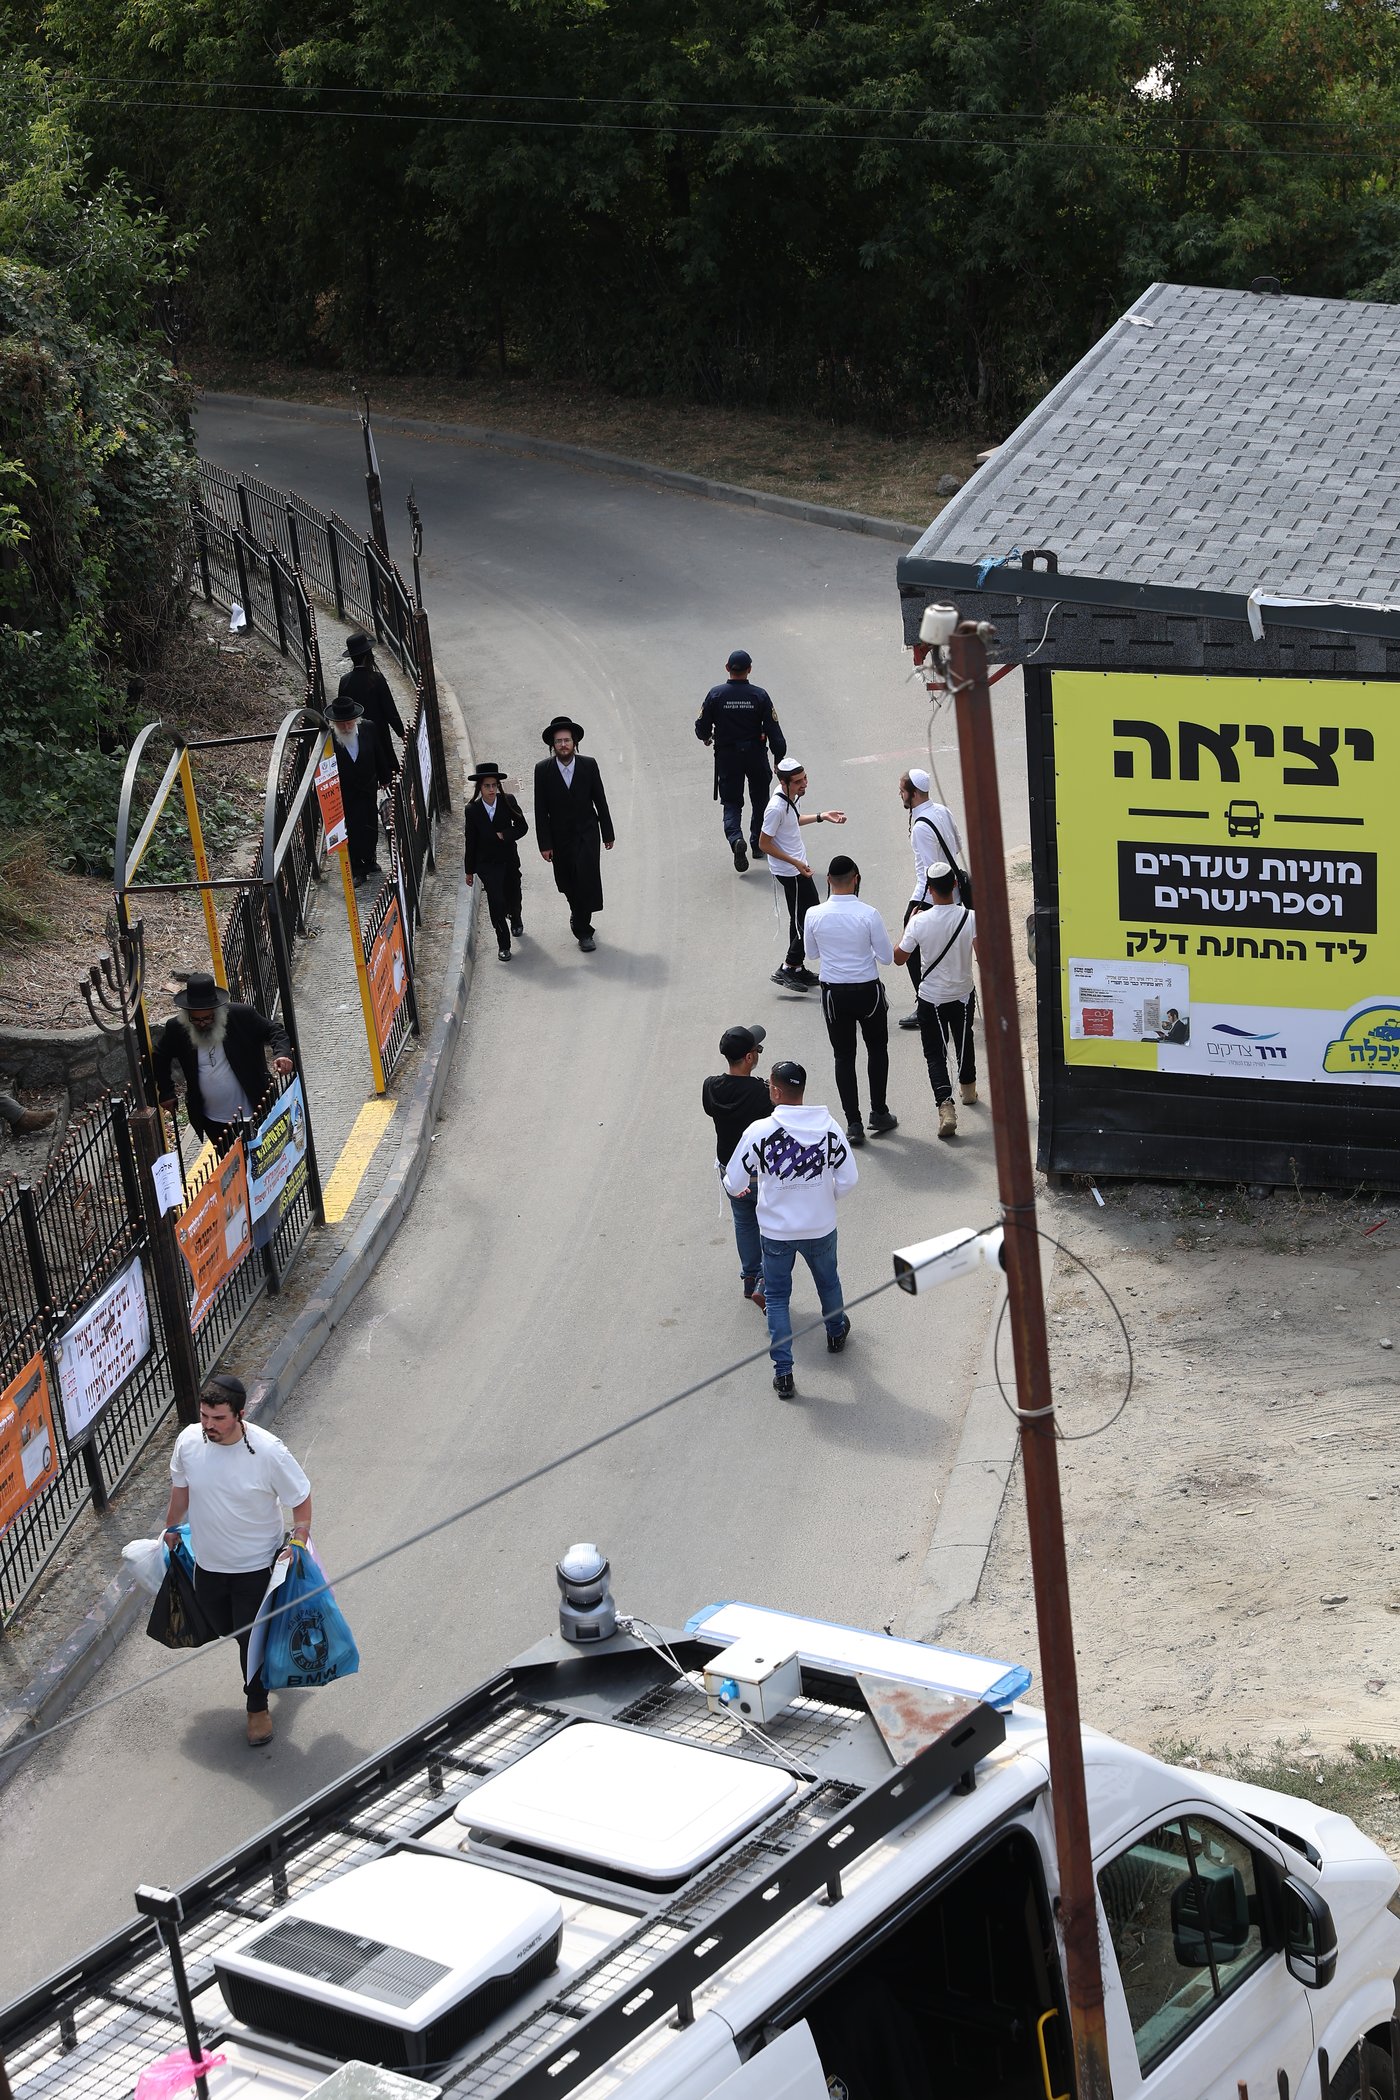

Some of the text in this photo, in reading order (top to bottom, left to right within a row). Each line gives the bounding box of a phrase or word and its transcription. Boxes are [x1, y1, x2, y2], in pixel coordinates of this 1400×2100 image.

[1113, 719, 1374, 787] יציאה
[1135, 852, 1362, 885] מוניות טנדרים
[1154, 885, 1343, 917] וספרינטרים
[1126, 928, 1368, 965] ליד התחנת דלק
[1207, 1042, 1287, 1060] דרך צדיקים
[287, 1664, 338, 1687] BMW
